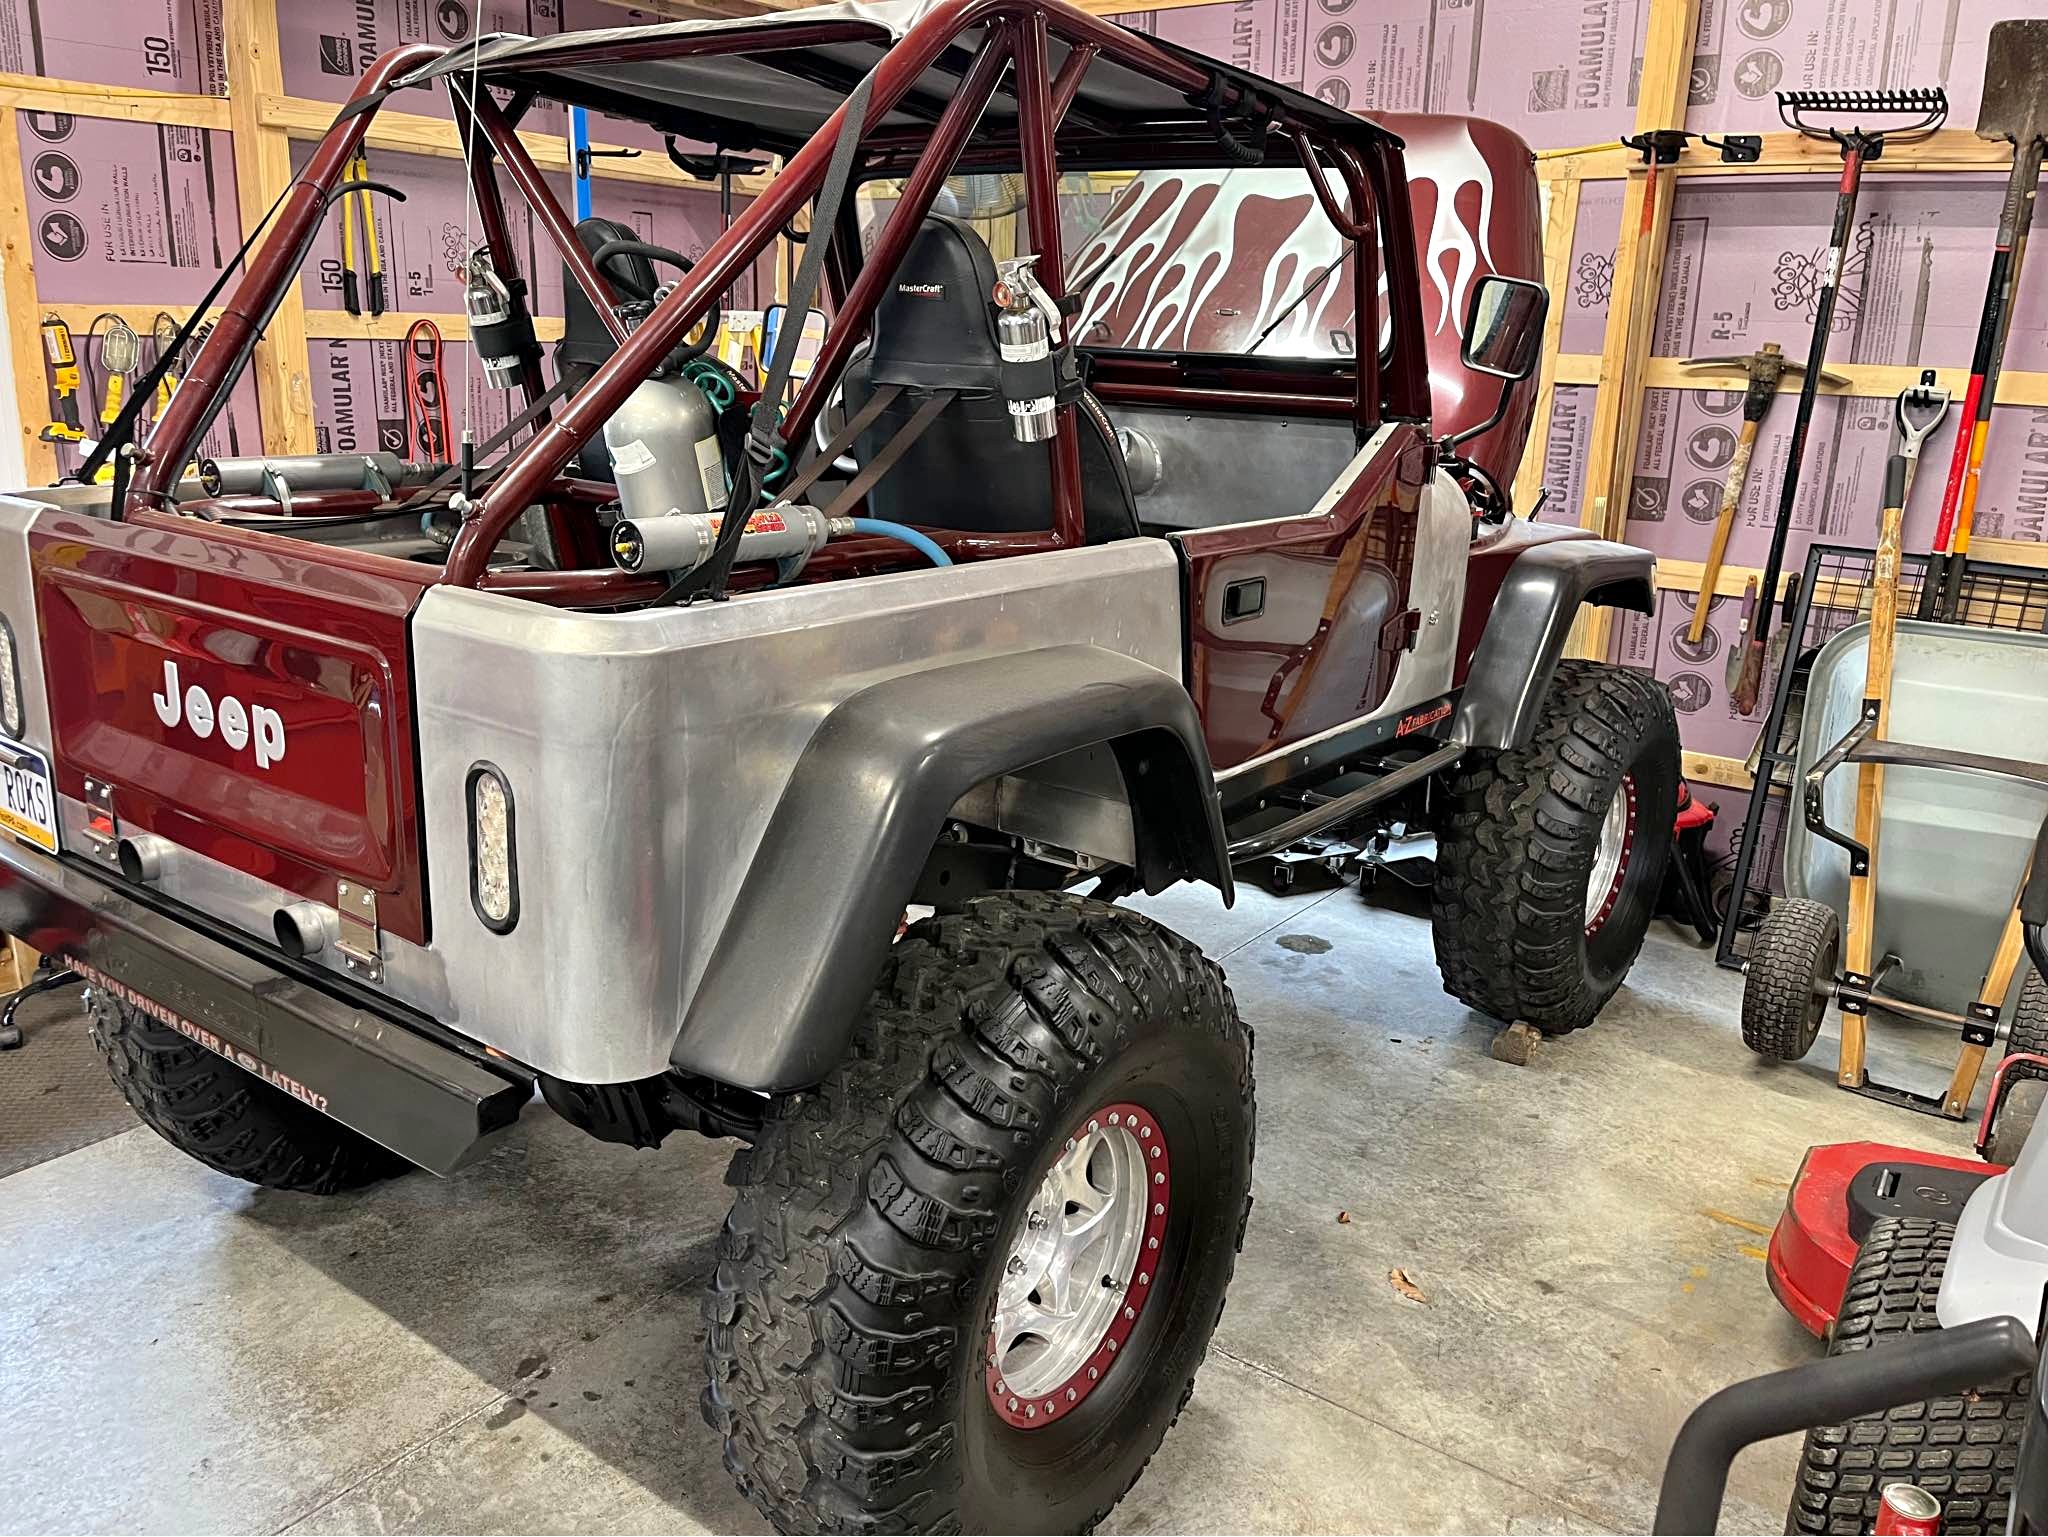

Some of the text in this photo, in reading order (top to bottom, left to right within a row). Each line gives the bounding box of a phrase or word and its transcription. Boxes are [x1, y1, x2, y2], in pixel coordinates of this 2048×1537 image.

[144, 37, 171, 75] 150
[218, 73, 224, 81] IN
[320, 260, 343, 294] 150
[408, 272, 422, 296] R-5
[1679, 286, 1687, 300] AND
[1677, 302, 1685, 315] USA
[1675, 317, 1684, 330] THE
[1711, 312, 1732, 339] R-5
[1655, 429, 1664, 456] FEDERAL
[1749, 485, 1760, 504] USE
[1640, 623, 1648, 648] FEDERAL
[153, 659, 286, 769] Jeep
[63, 954, 328, 1113] HAVE YOU DRIVEN OVER A LATELY?
